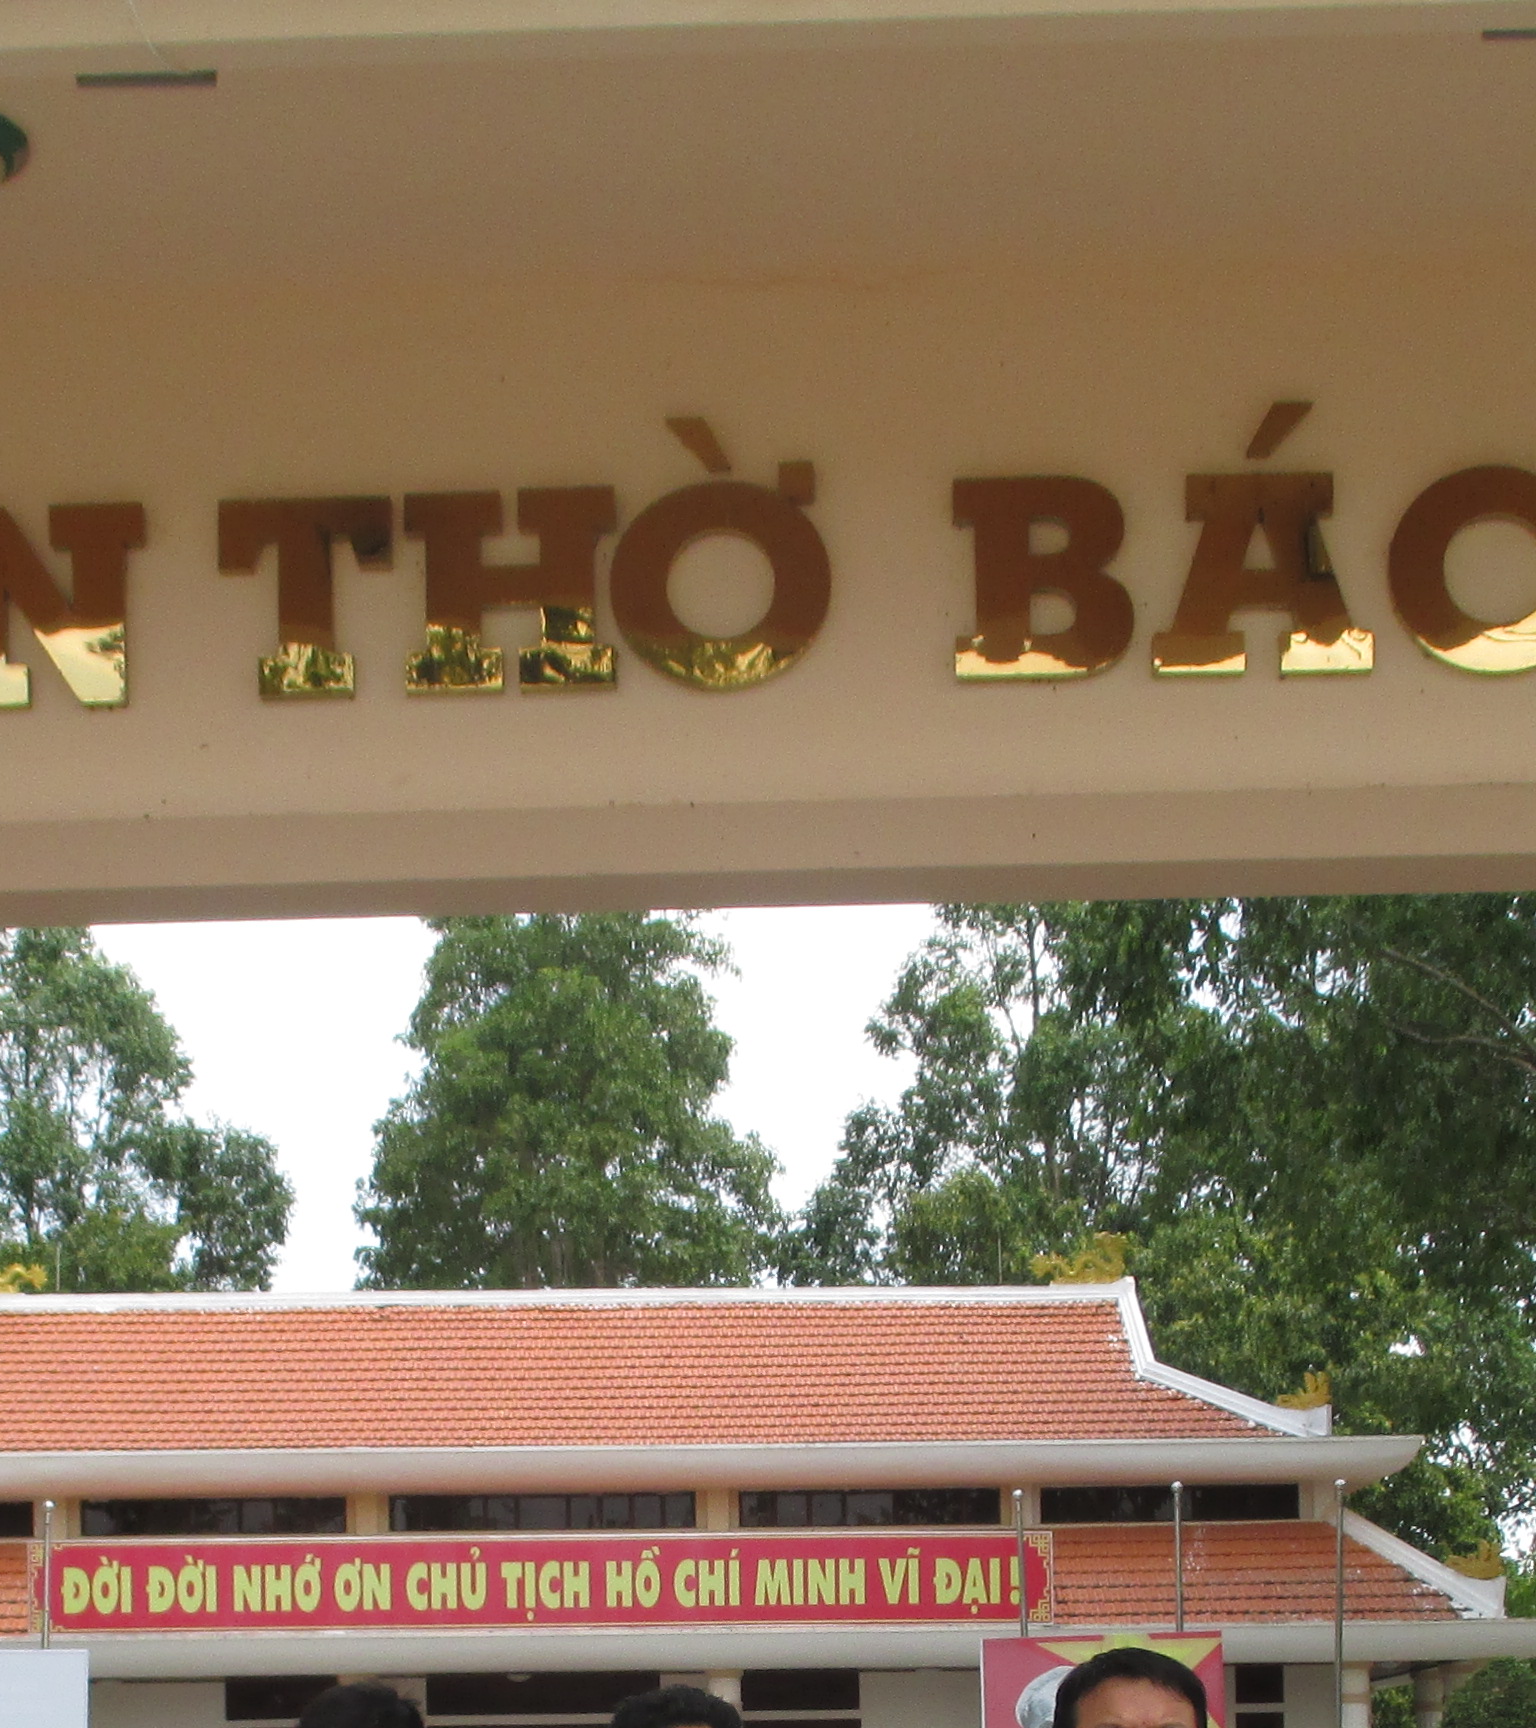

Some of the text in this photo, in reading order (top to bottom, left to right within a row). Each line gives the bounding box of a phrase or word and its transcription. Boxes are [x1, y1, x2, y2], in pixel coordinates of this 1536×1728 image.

[217, 415, 832, 702] THỜ
[61, 1556, 132, 1614] ĐỜI
[146, 1555, 218, 1613] ĐỜI
[233, 1553, 322, 1613] NHỚ
[333, 1557, 392, 1611] ƠN
[405, 1546, 487, 1611] CHỦ
[500, 1558, 590, 1622] TỊCH
[605, 1545, 662, 1608] HỒ
[672, 1547, 741, 1608] CHÍ
[754, 1557, 866, 1607] MINH
[877, 1547, 921, 1605] VĨ
